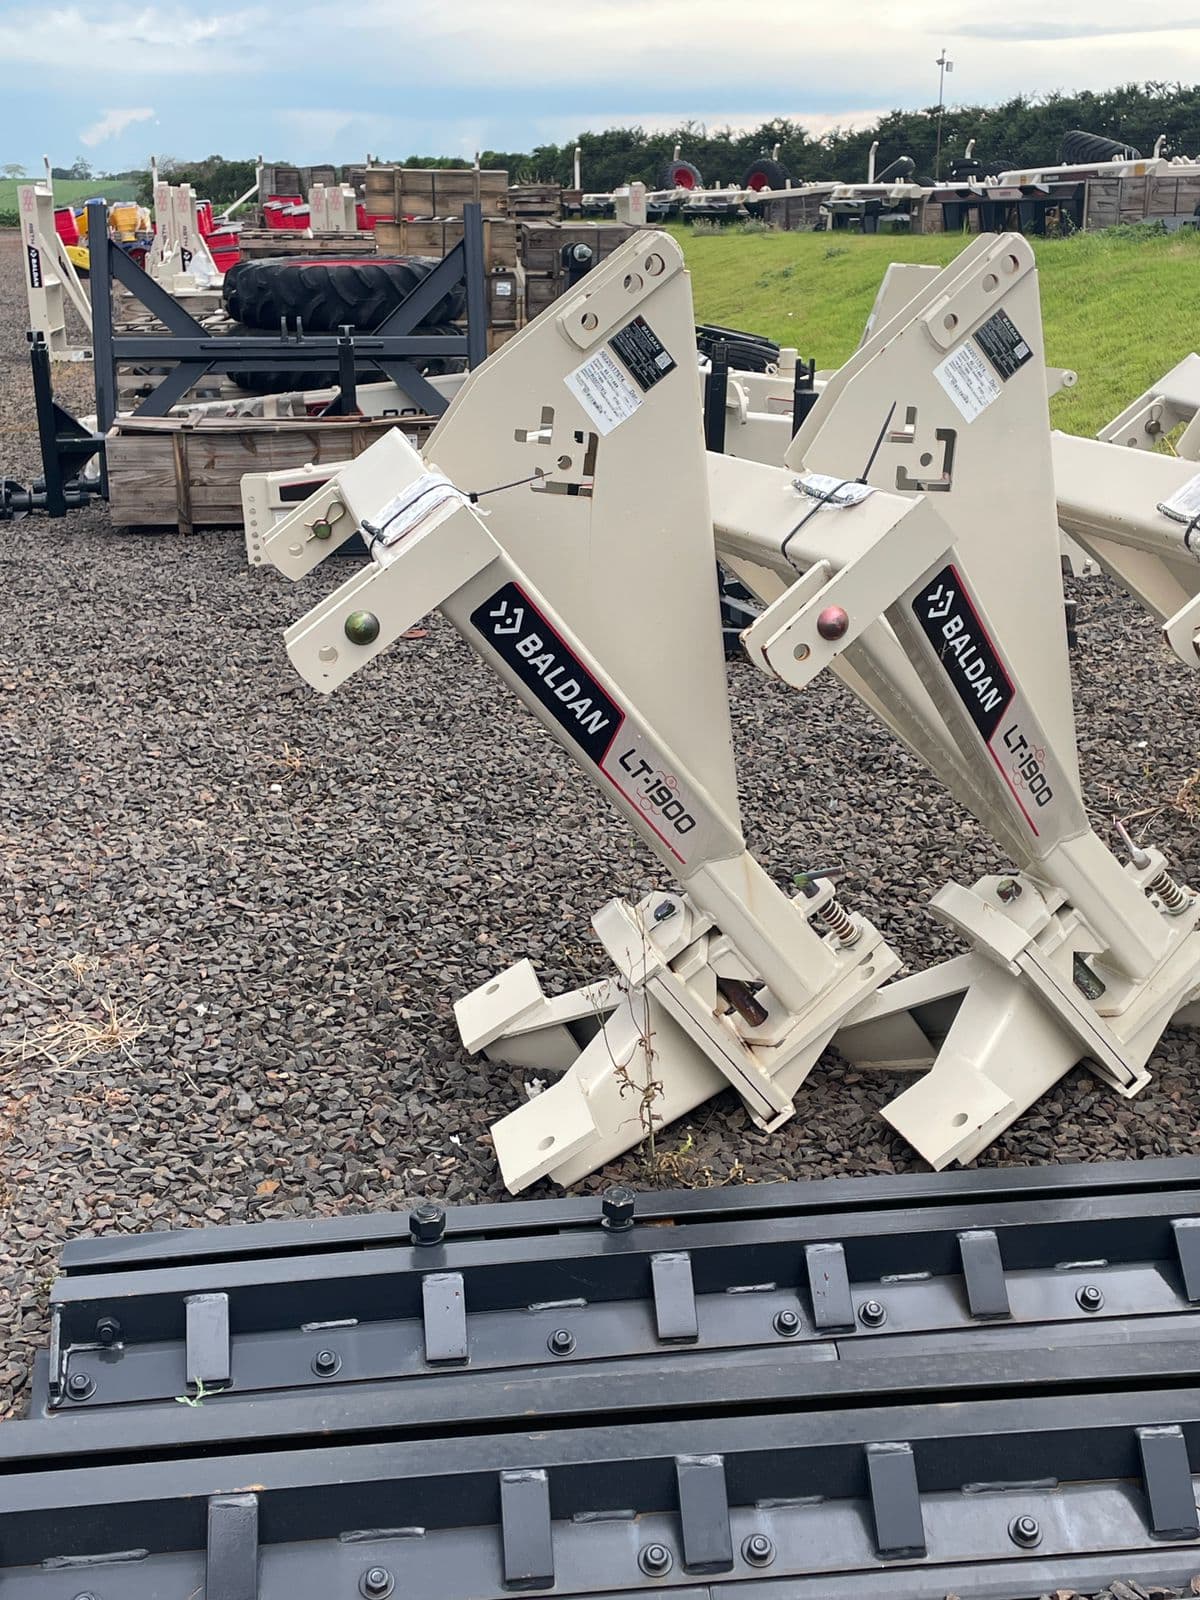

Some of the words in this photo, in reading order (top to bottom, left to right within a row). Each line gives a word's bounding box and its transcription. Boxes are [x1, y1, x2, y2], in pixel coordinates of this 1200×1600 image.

[31, 259, 39, 287] BALDAN
[641, 325, 661, 350] BALDAN
[515, 633, 609, 736] BALDAN
[942, 614, 1004, 713] BALDAN
[619, 748, 697, 836] LT-1900
[1003, 724, 1054, 808] LT-1900
